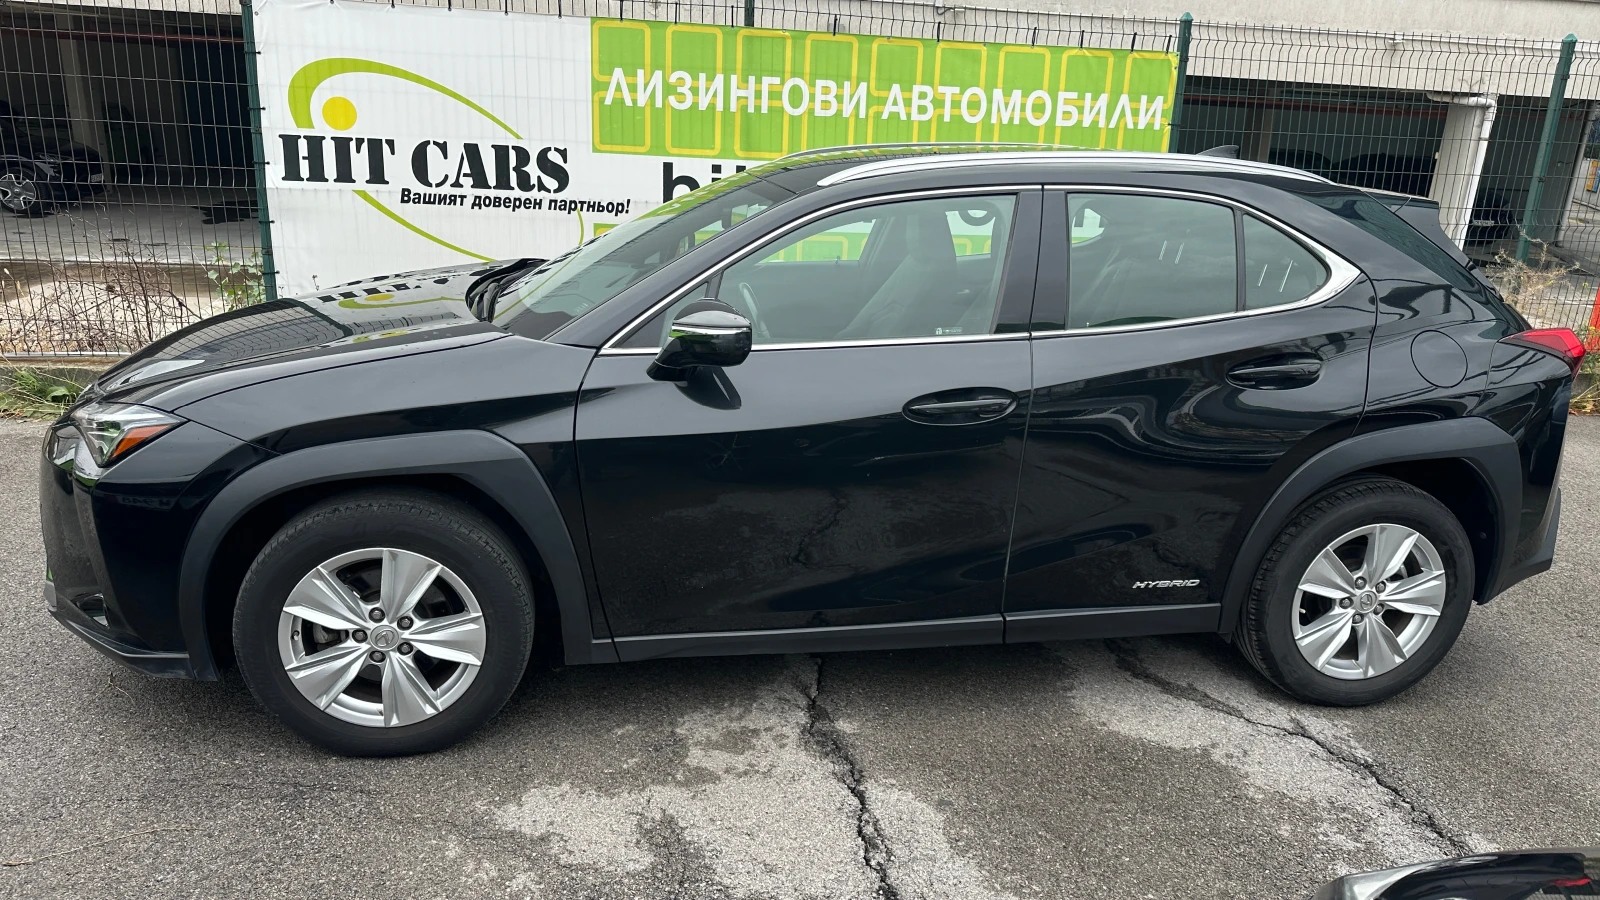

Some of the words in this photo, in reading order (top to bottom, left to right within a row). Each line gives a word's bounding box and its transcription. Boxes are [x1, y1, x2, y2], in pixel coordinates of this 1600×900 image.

[604, 67, 867, 119] ЛИЗИНГОВИ
[881, 83, 1164, 130] АВТОМОБИЛИ
[278, 134, 396, 185] HIT
[411, 139, 570, 194] CARS
[400, 188, 467, 207] Вашият
[471, 194, 543, 212] доверен
[547, 199, 631, 217] партньор!
[1132, 579, 1200, 589] HYBRID
